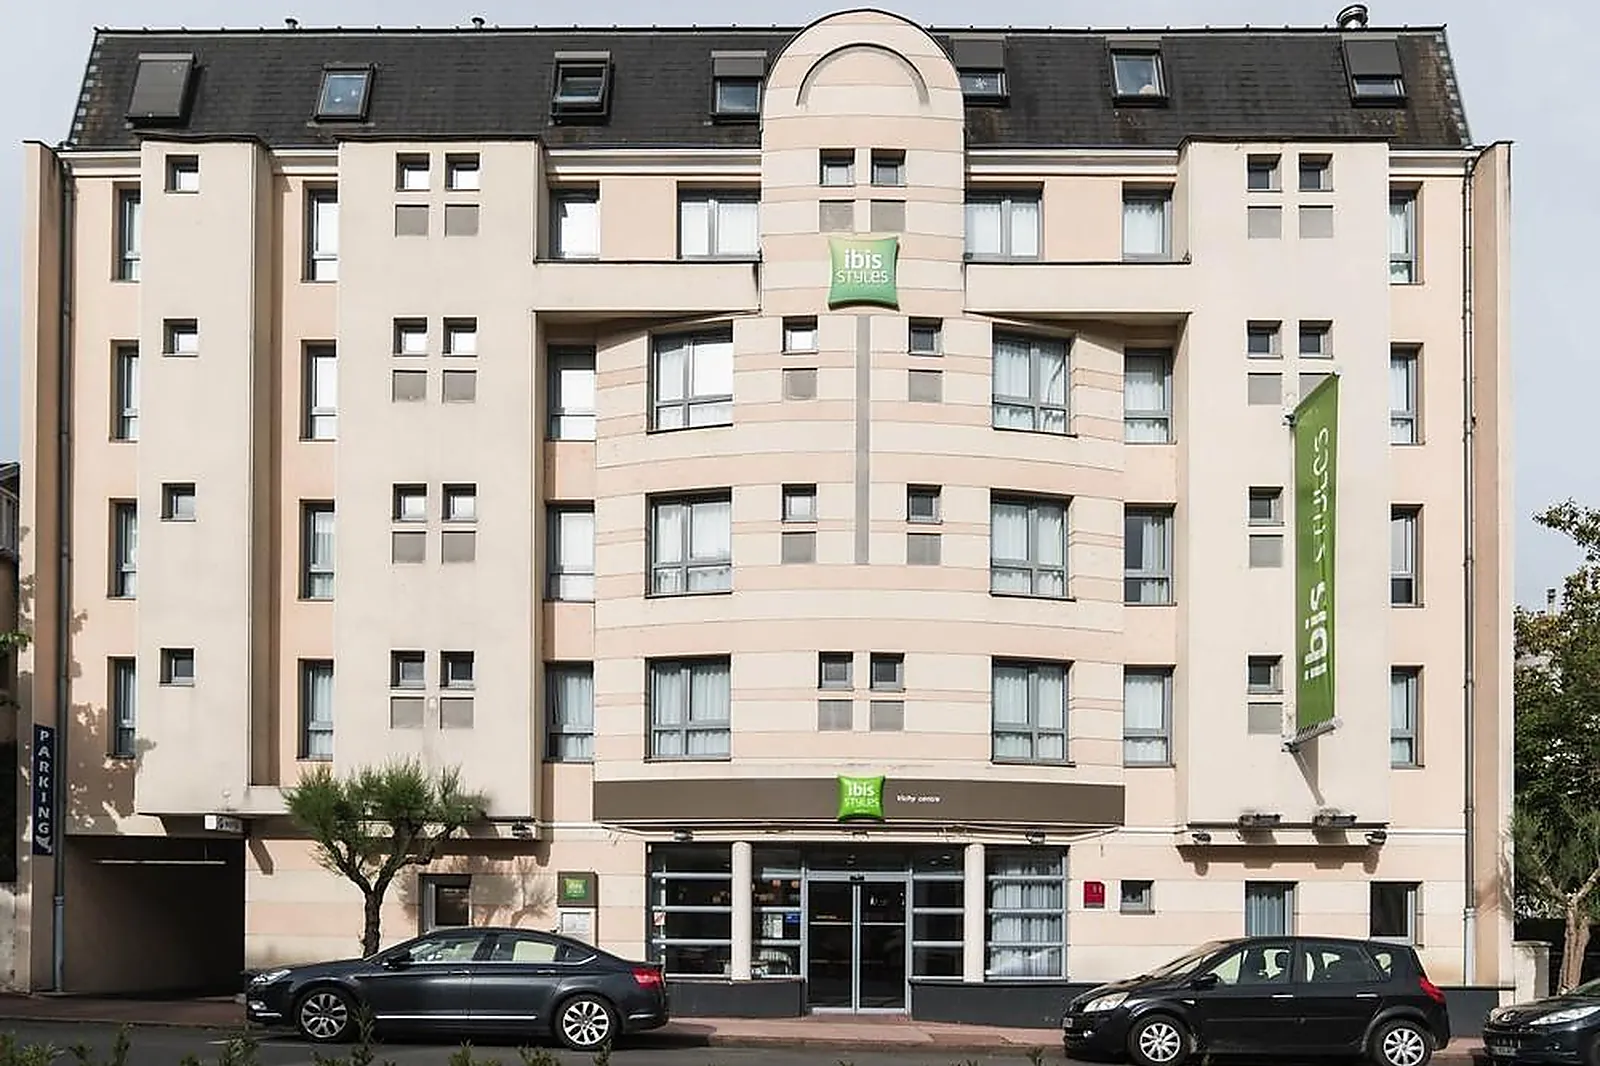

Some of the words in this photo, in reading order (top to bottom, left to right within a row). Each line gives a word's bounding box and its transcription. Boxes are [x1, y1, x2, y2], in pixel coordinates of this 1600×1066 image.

[845, 248, 882, 269] ibis
[1305, 581, 1327, 680] ibis
[38, 730, 51, 834] PARKING
[848, 782, 876, 796] ibis
